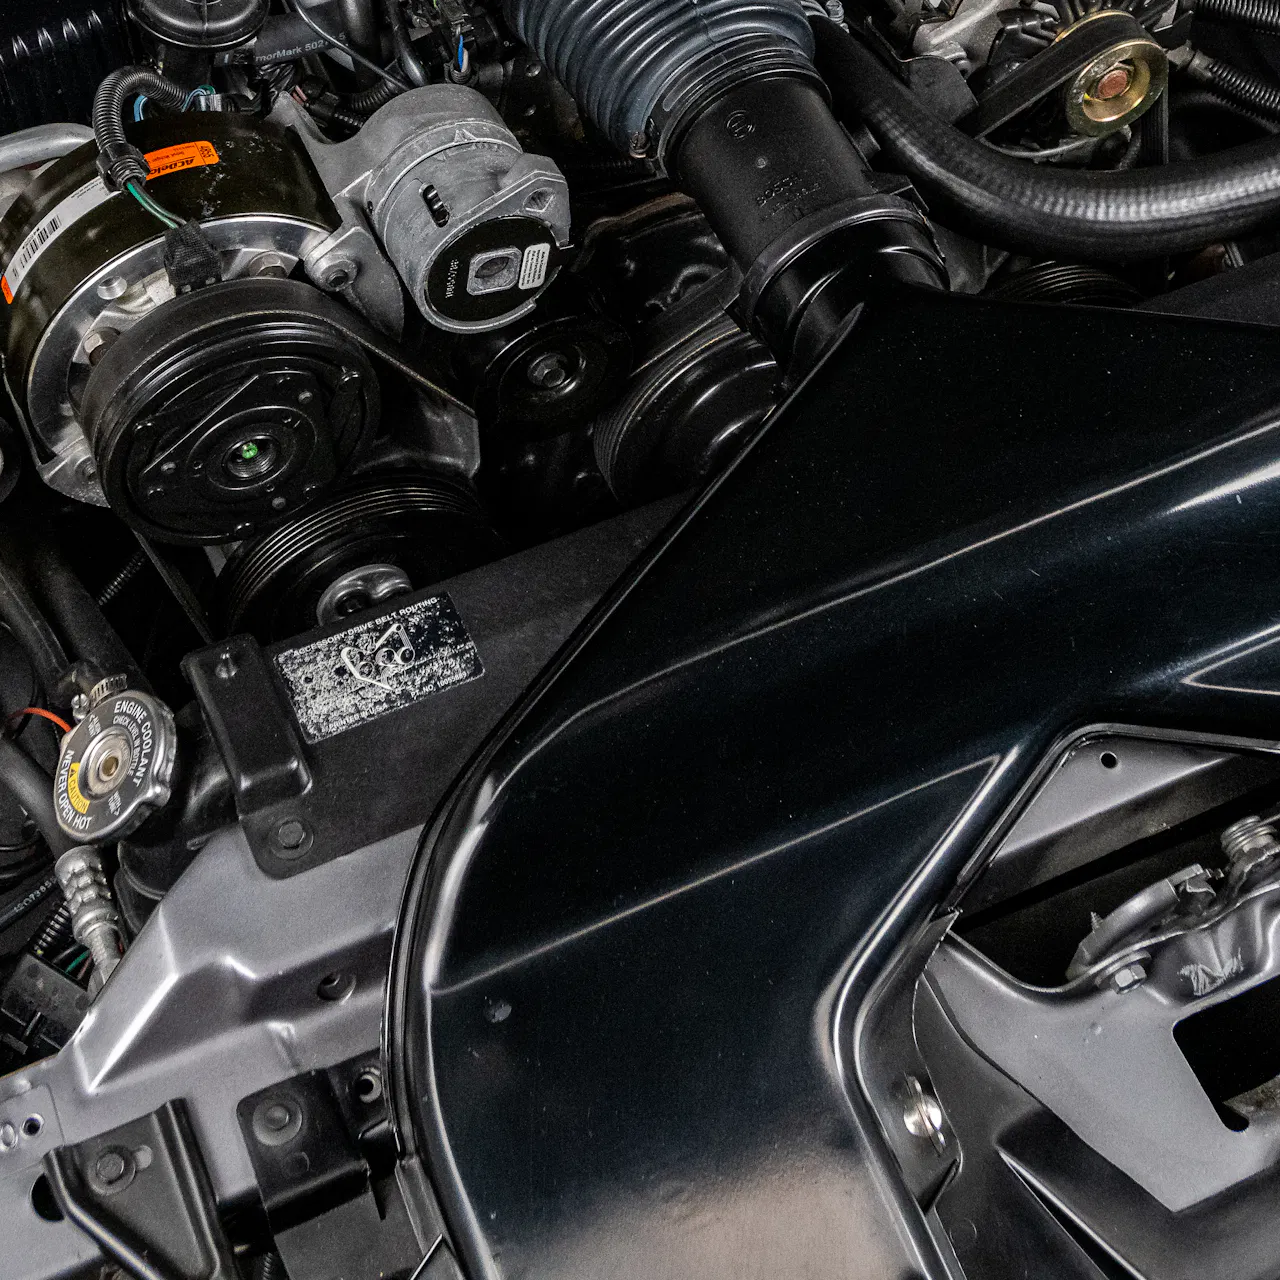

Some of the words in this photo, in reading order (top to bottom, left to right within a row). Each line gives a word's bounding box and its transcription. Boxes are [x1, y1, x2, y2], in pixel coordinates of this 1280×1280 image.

[255, 46, 303, 62] morMark
[150, 158, 195, 175] ACDelc
[293, 632, 346, 657] ACCESSORY
[347, 621, 373, 638] DRIVE
[374, 611, 399, 627] BELT
[399, 596, 438, 616] ROUTING
[113, 716, 129, 729] CHECK
[127, 720, 140, 740] LEVEL
[114, 700, 148, 725] ENGINE
[132, 721, 153, 788] COOLANT
[58, 749, 75, 793] NEVER
[127, 747, 141, 777] BOTTLE
[58, 792, 75, 823] OPEN
[68, 779, 89, 813] CAUTION
[72, 815, 93, 830] HOT
